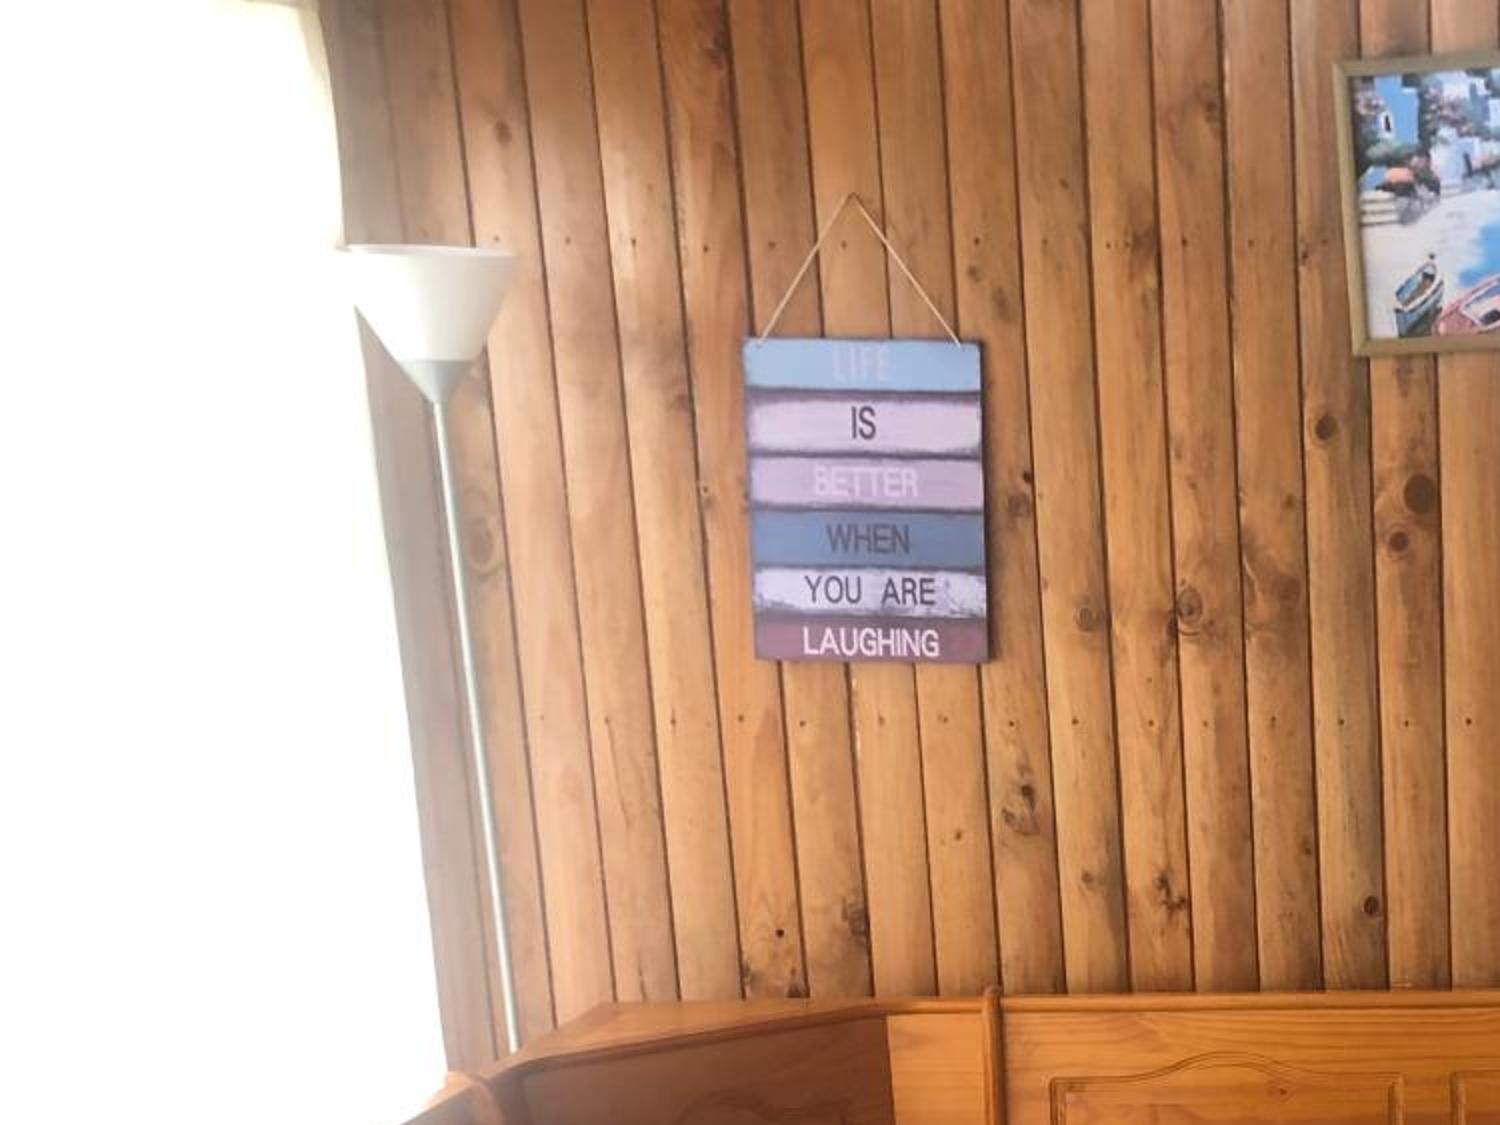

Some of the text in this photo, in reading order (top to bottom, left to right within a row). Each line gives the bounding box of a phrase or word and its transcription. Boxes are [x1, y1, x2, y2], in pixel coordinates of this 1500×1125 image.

[851, 405, 876, 440] IS
[814, 467, 919, 498] BETTER
[826, 524, 910, 554] WHEN
[805, 575, 936, 606] YOU ARE
[803, 626, 940, 658] LAUGHING
